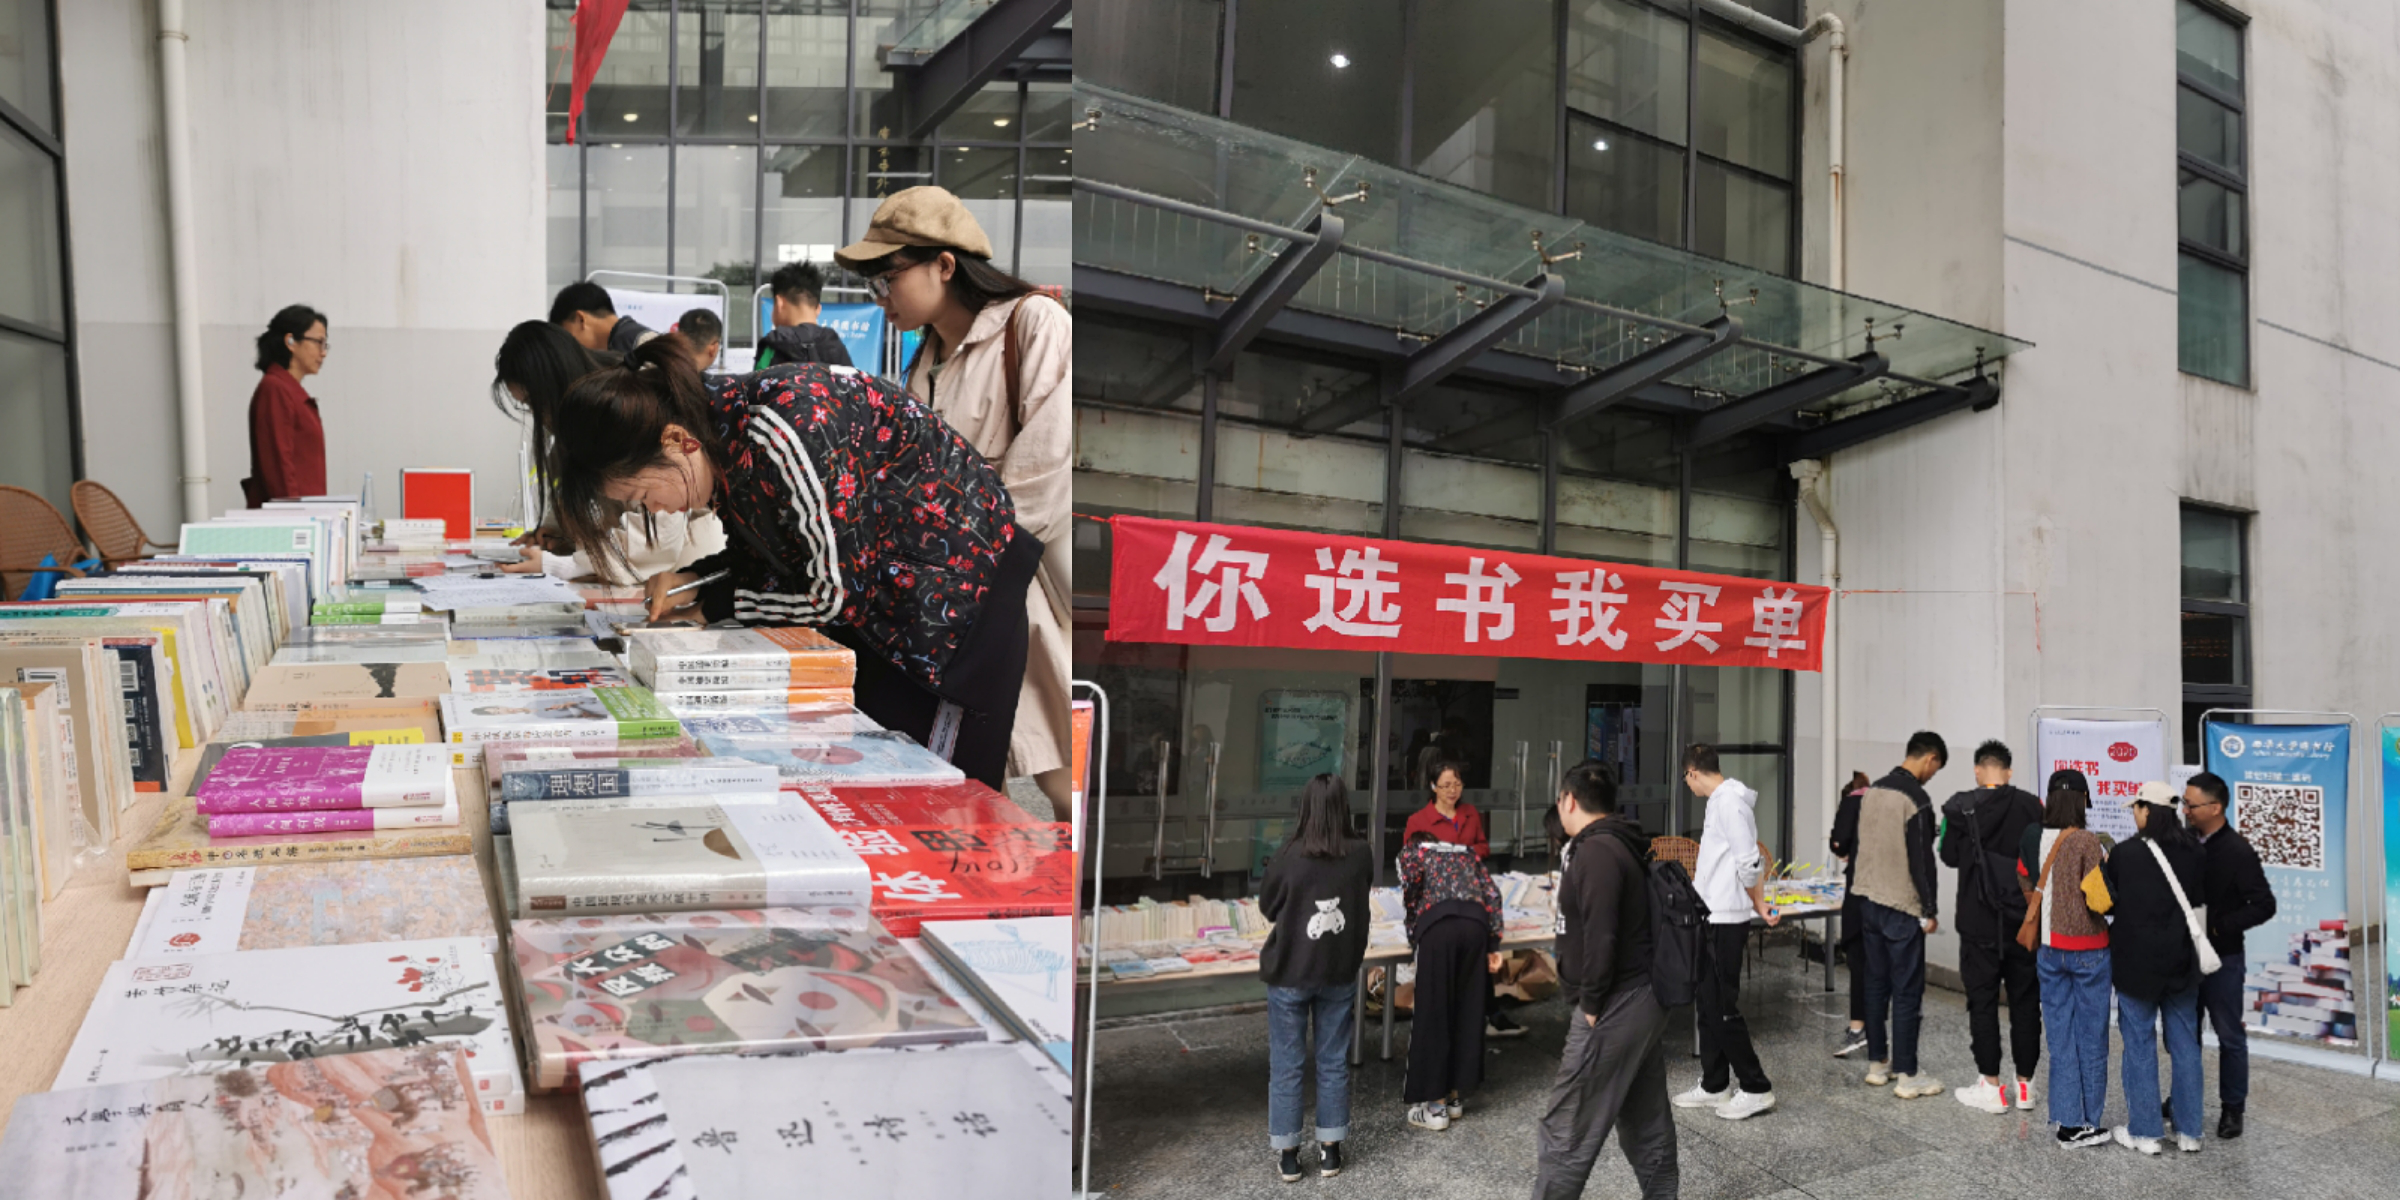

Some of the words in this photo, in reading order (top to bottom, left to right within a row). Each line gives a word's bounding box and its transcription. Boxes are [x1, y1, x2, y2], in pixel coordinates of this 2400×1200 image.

[1152, 530, 1806, 658] 你选书我买单
[549, 772, 620, 797] 理想国
[567, 932, 676, 977] 大众的
[597, 962, 676, 997] 反叛
[691, 1110, 998, 1154] 鲁迅诗话
